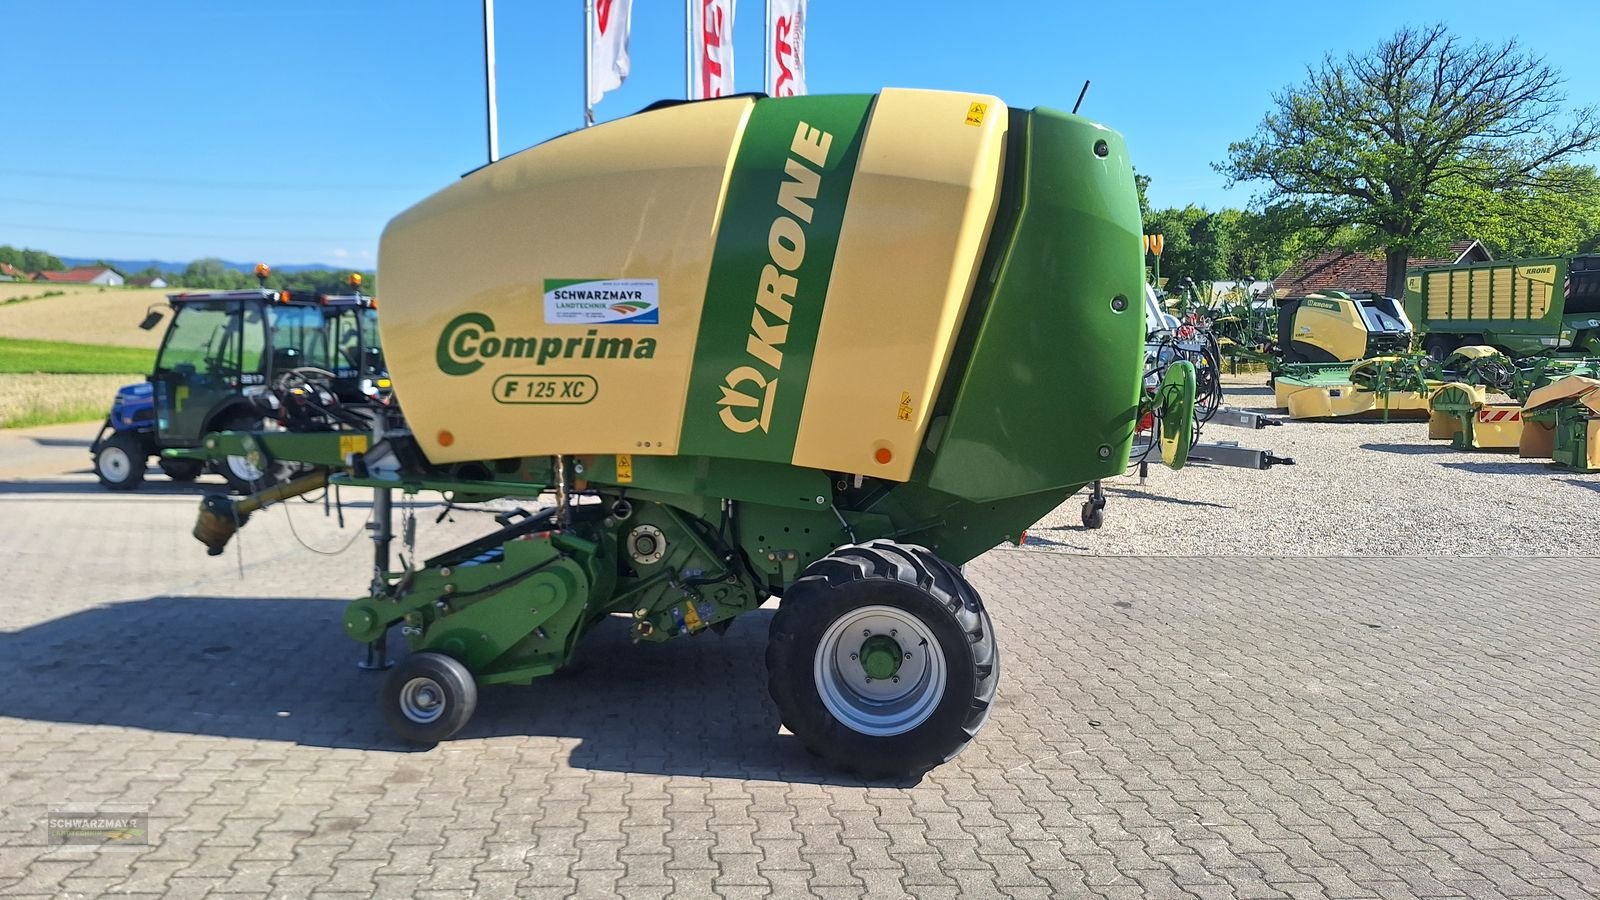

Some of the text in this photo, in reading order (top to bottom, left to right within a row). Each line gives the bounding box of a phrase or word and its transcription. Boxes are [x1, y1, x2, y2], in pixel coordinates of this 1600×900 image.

[746, 120, 833, 371] KRONE
[1526, 267, 1551, 275] KRONE
[554, 291, 642, 300] SCHWARZMAYR
[436, 312, 657, 376] Comprima
[504, 381, 585, 398] F 125 XC
